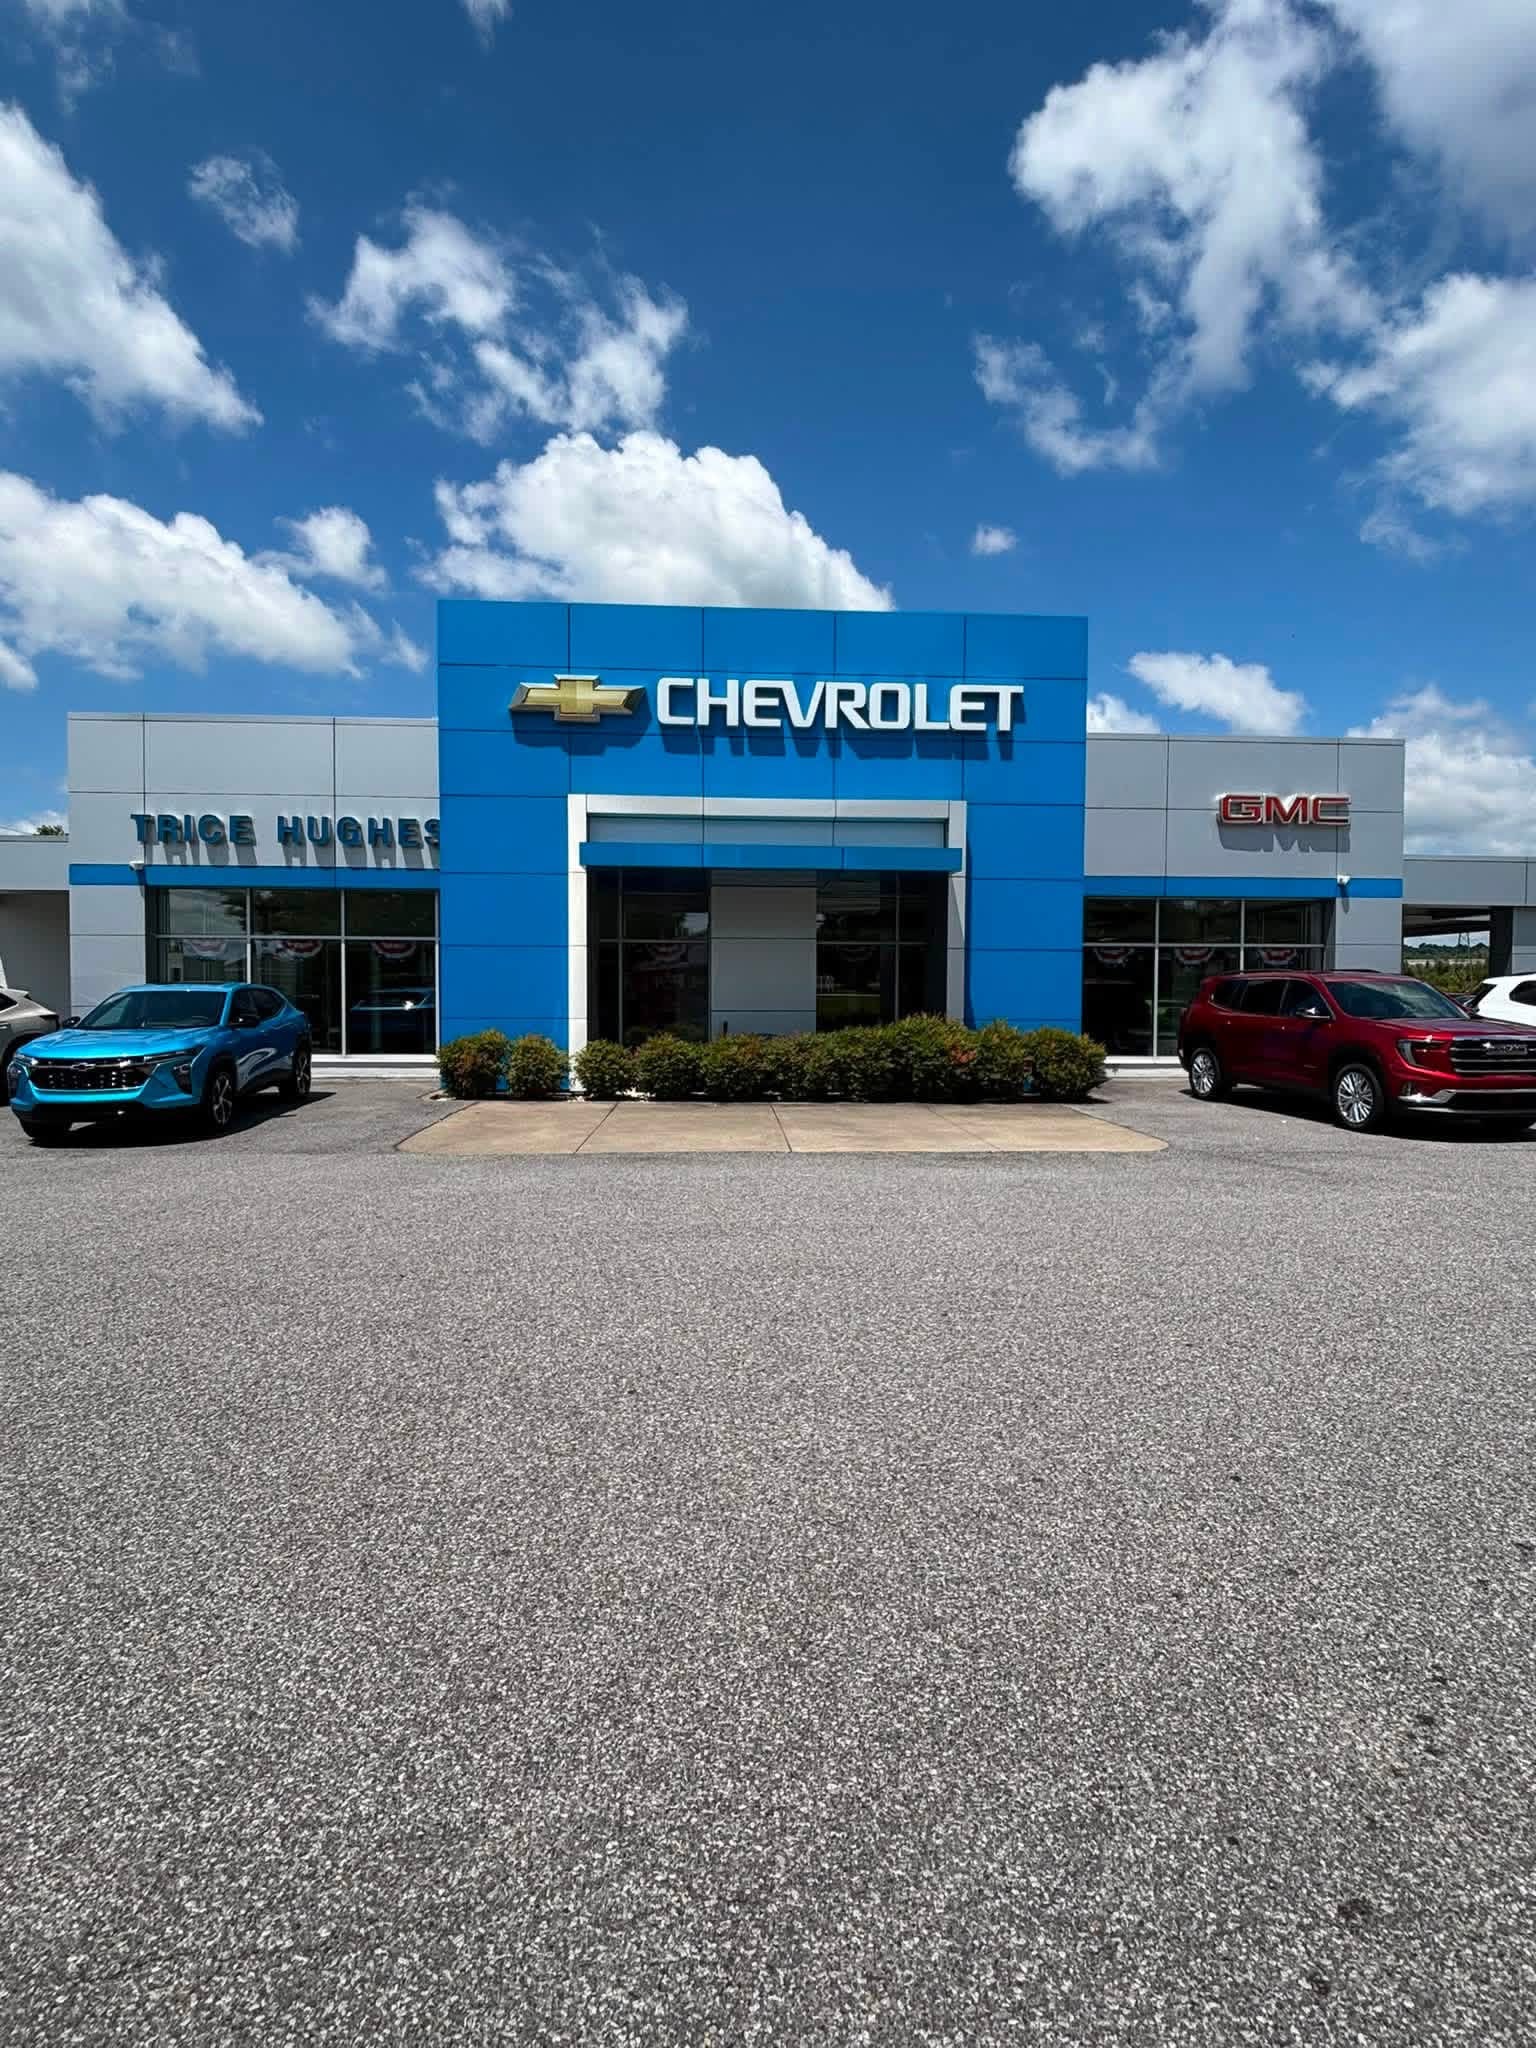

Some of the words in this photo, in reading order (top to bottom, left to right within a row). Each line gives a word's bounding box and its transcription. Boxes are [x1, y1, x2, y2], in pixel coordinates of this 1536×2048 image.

[657, 677, 1025, 732] CHEVROLET
[1220, 793, 1351, 825] GMC
[131, 814, 256, 846] TRICE
